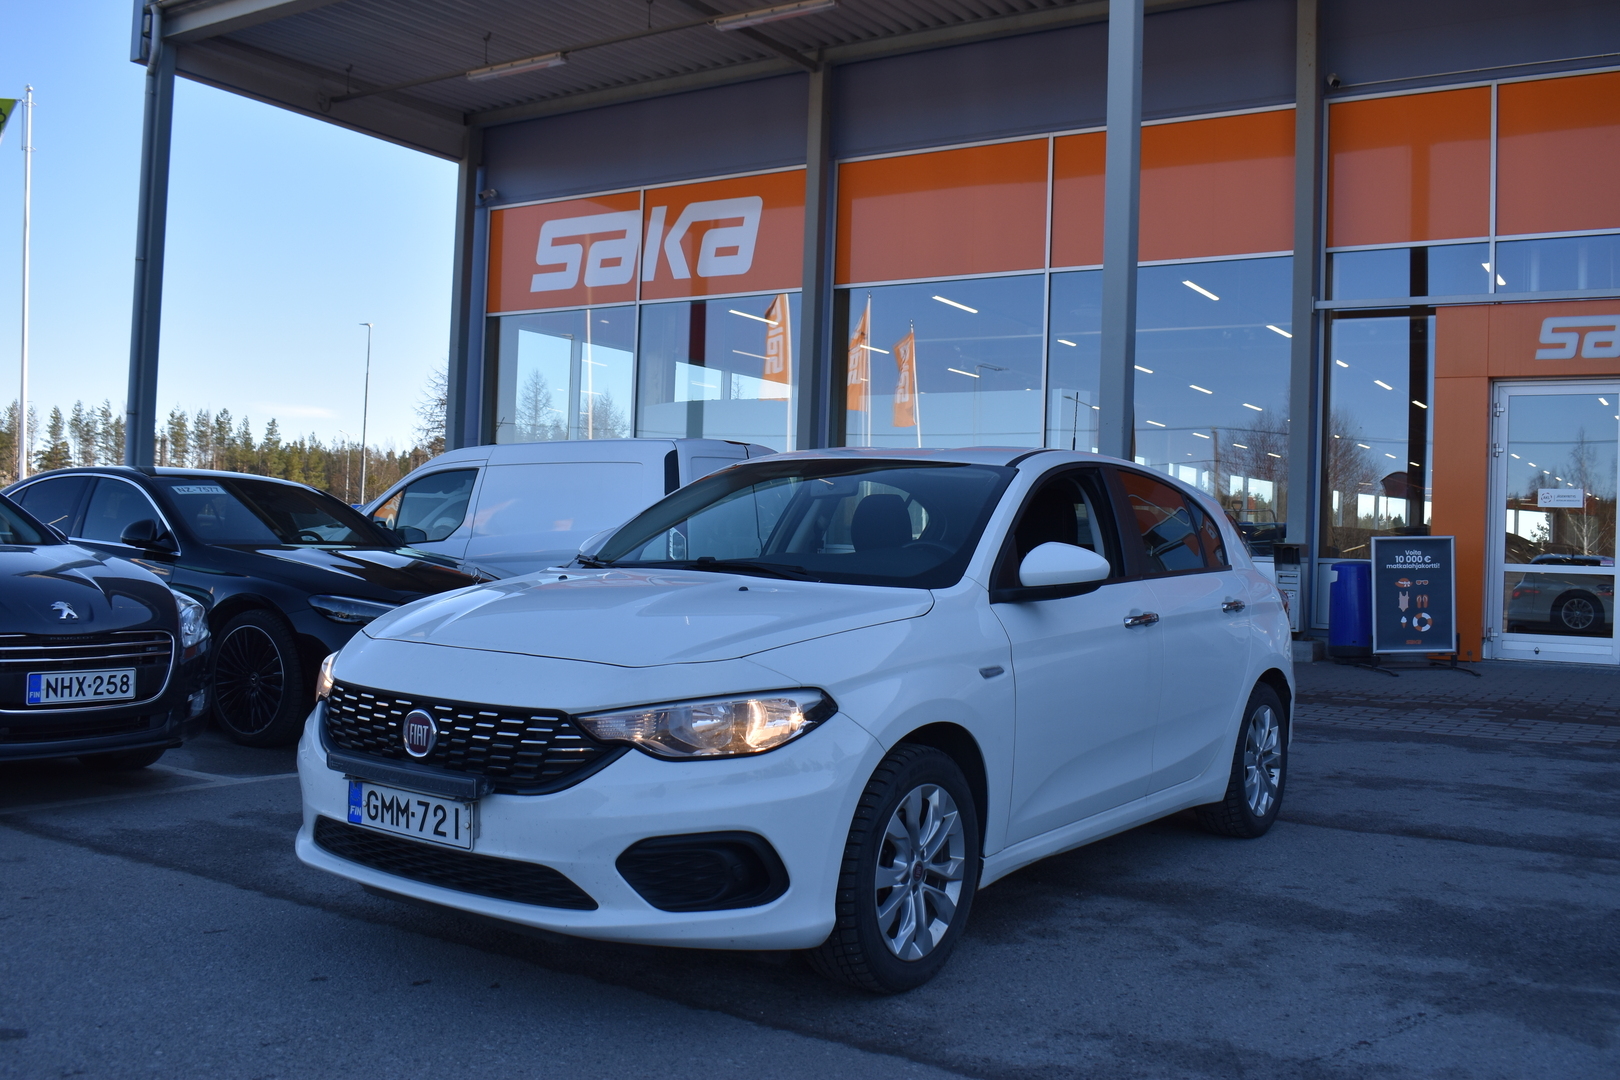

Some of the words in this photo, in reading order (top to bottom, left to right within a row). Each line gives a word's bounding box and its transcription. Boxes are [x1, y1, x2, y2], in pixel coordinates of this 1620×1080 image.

[1395, 555, 1405, 563] 10
[1405, 555, 1423, 563] 000
[1424, 555, 1432, 563] €
[29, 691, 41, 699] FIN
[45, 674, 130, 699] NHX-258
[409, 723, 429, 747] FIAT
[350, 805, 362, 817] FIN
[366, 790, 460, 840] GMM-721
